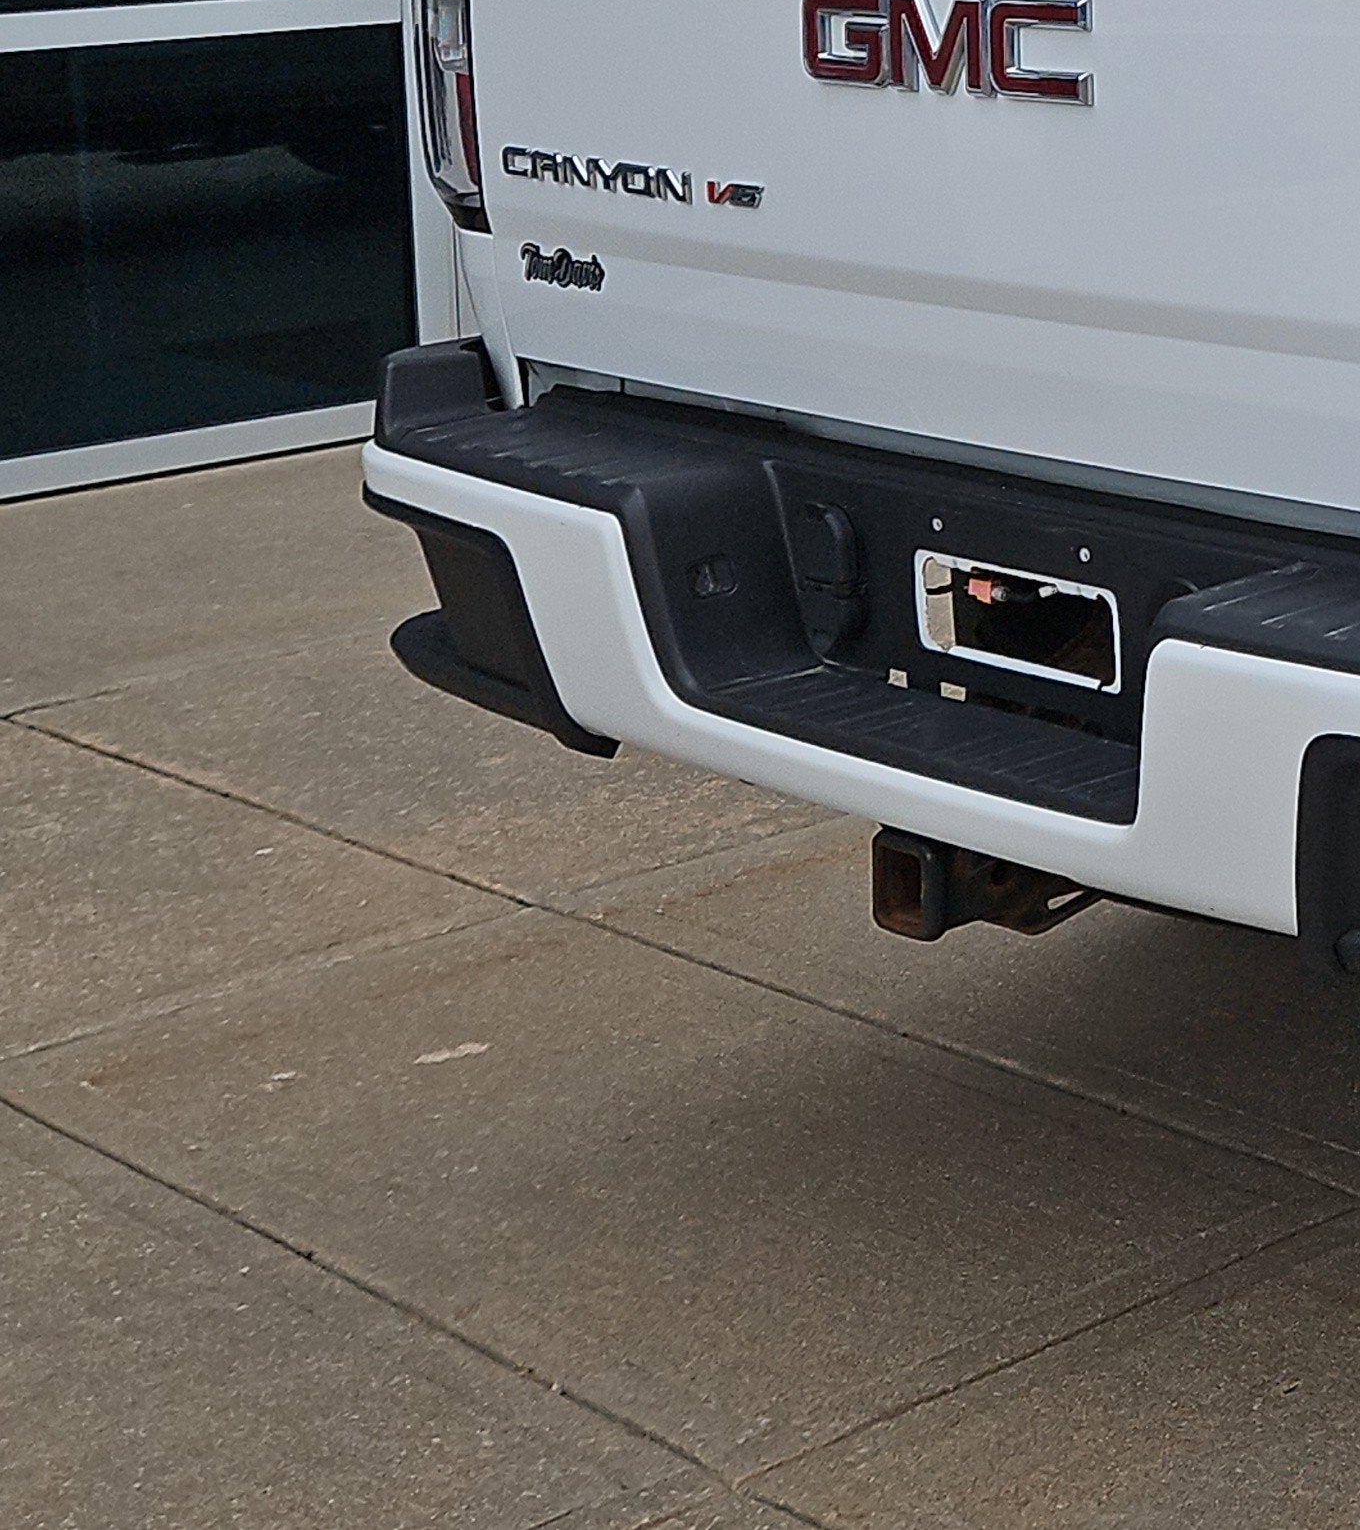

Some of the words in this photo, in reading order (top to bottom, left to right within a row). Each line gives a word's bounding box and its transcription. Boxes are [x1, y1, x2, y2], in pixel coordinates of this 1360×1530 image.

[501, 146, 694, 206] CANYON
[706, 181, 765, 208] V6
[520, 242, 555, 285] Tom
